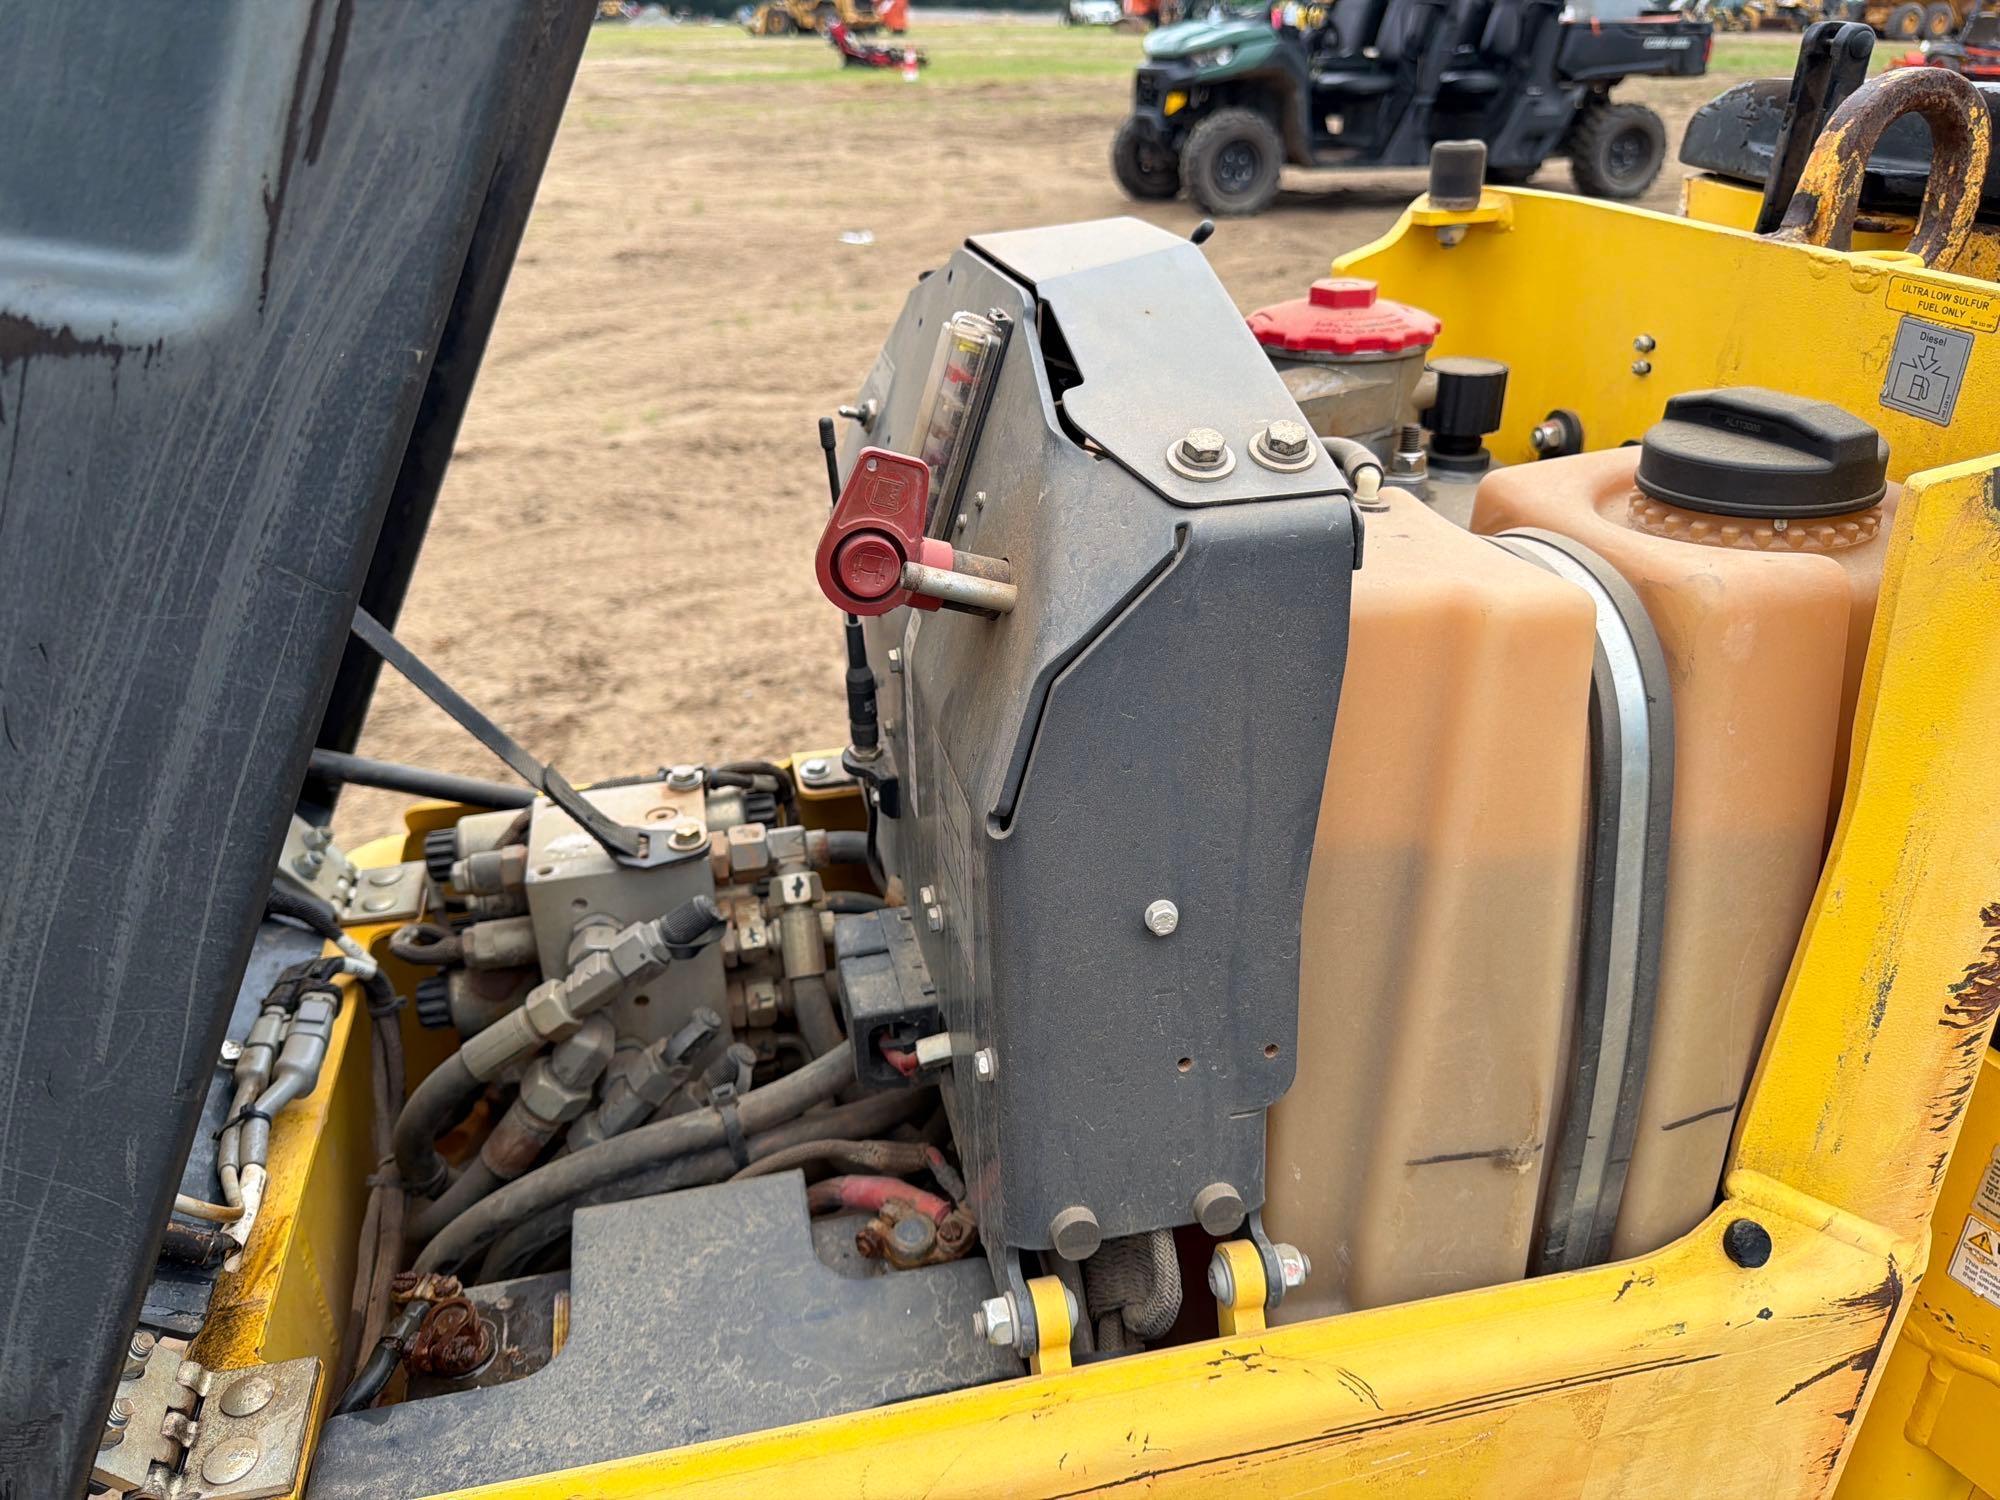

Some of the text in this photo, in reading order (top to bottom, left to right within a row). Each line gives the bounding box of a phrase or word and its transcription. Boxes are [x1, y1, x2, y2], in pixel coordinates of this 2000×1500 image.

[1902, 284, 1990, 311] ULTRA LOW SULFUR
[1917, 301, 1966, 318] FUEL ONLY
[1920, 331, 1947, 347] Diesel
[1964, 1265, 1978, 1277] that
[1965, 1257, 1979, 1270] This
[1962, 1271, 1976, 1282] that
[1977, 1280, 1989, 1291] are
